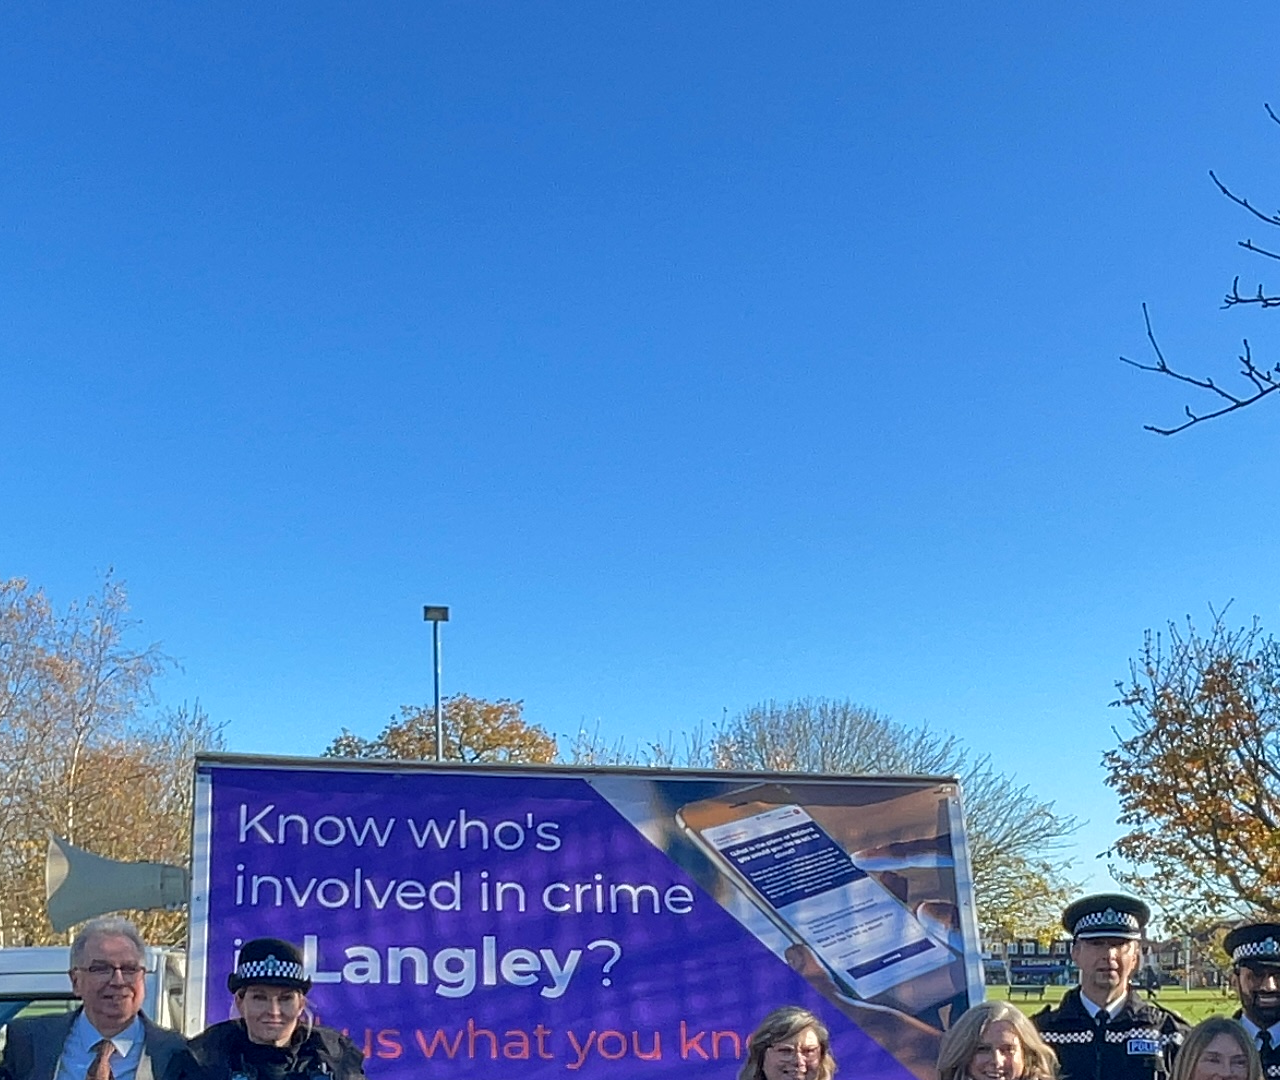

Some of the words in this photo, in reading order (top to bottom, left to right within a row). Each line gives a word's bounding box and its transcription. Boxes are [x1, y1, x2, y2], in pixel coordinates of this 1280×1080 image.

[238, 804, 396, 848] Know
[407, 808, 562, 851] who's
[235, 864, 462, 911] involved
[480, 871, 526, 913] in
[542, 873, 695, 915] crime
[303, 934, 623, 999] Langley?
[415, 1018, 555, 1060] what
[566, 1030, 662, 1070] you
[679, 1019, 752, 1060] kn
